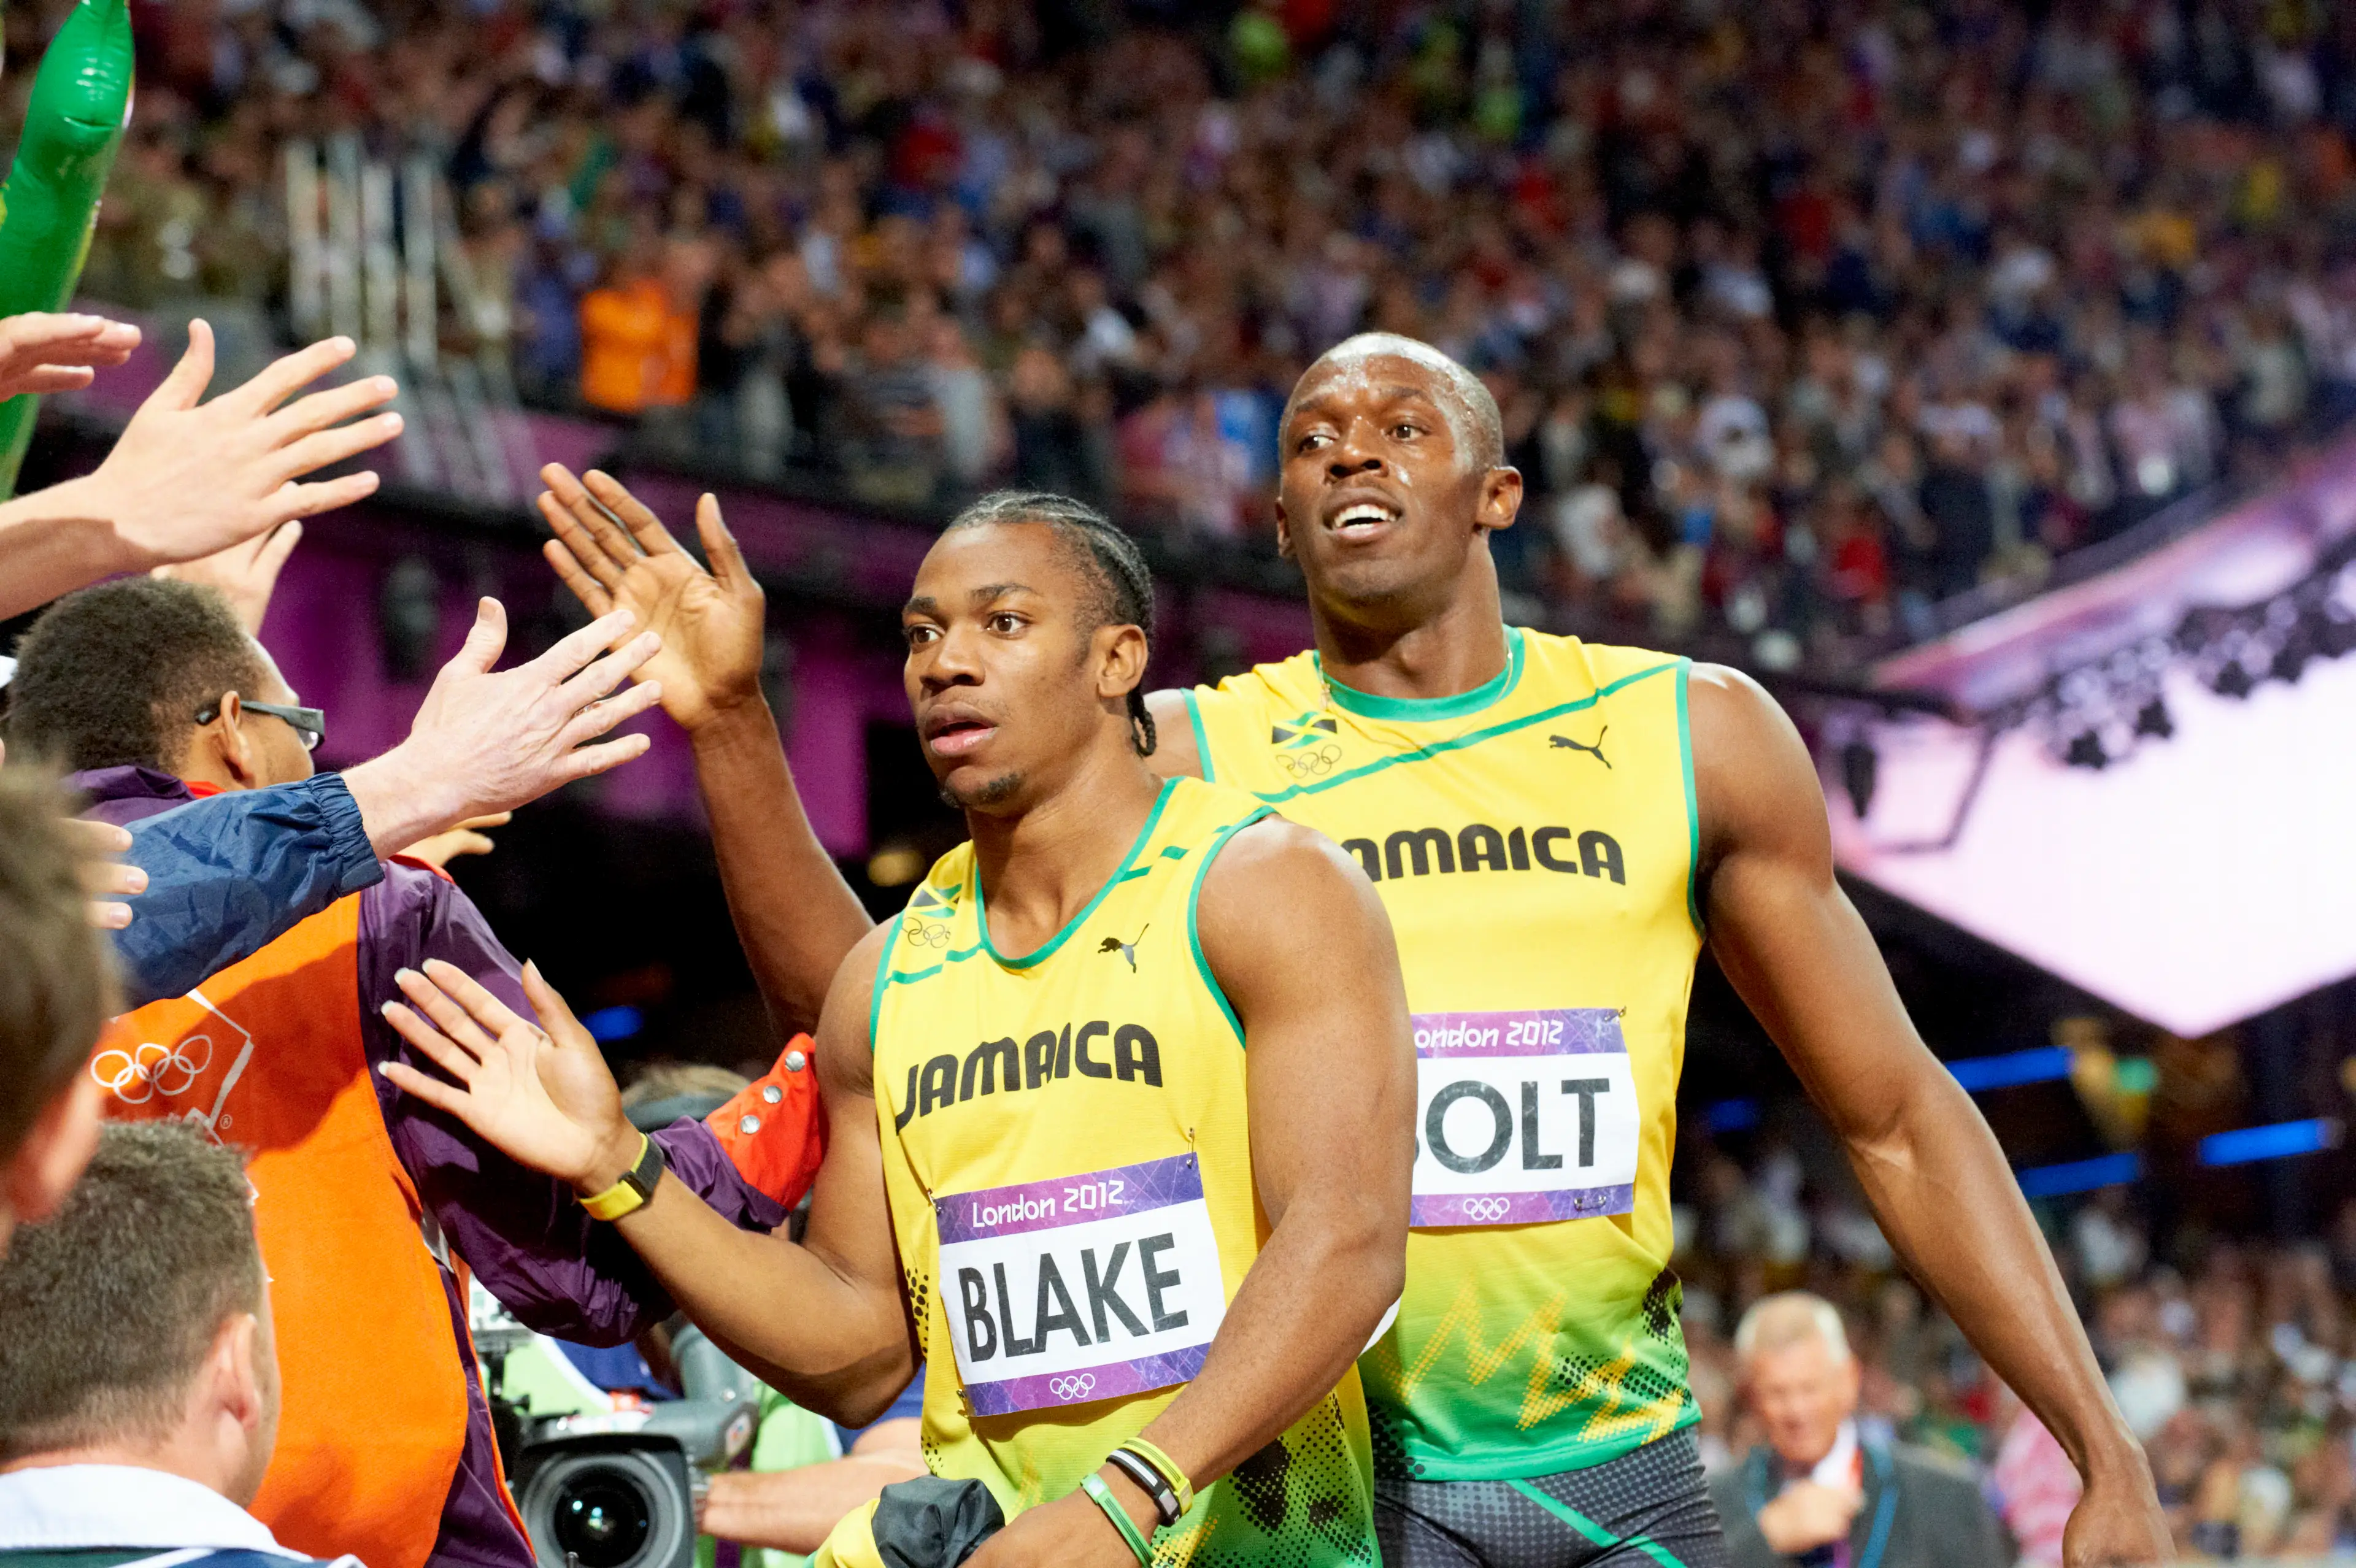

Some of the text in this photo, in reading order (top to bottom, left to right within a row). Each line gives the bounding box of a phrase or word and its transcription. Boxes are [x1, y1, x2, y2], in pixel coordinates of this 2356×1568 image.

[1341, 824, 1626, 886] AMAICA
[1414, 1019, 1564, 1048] ondon 2012
[895, 1020, 1163, 1136] JAMAICA
[1415, 1078, 1611, 1174] OLT
[972, 1180, 1125, 1228] London 2012
[958, 1232, 1189, 1363] BLAKE
